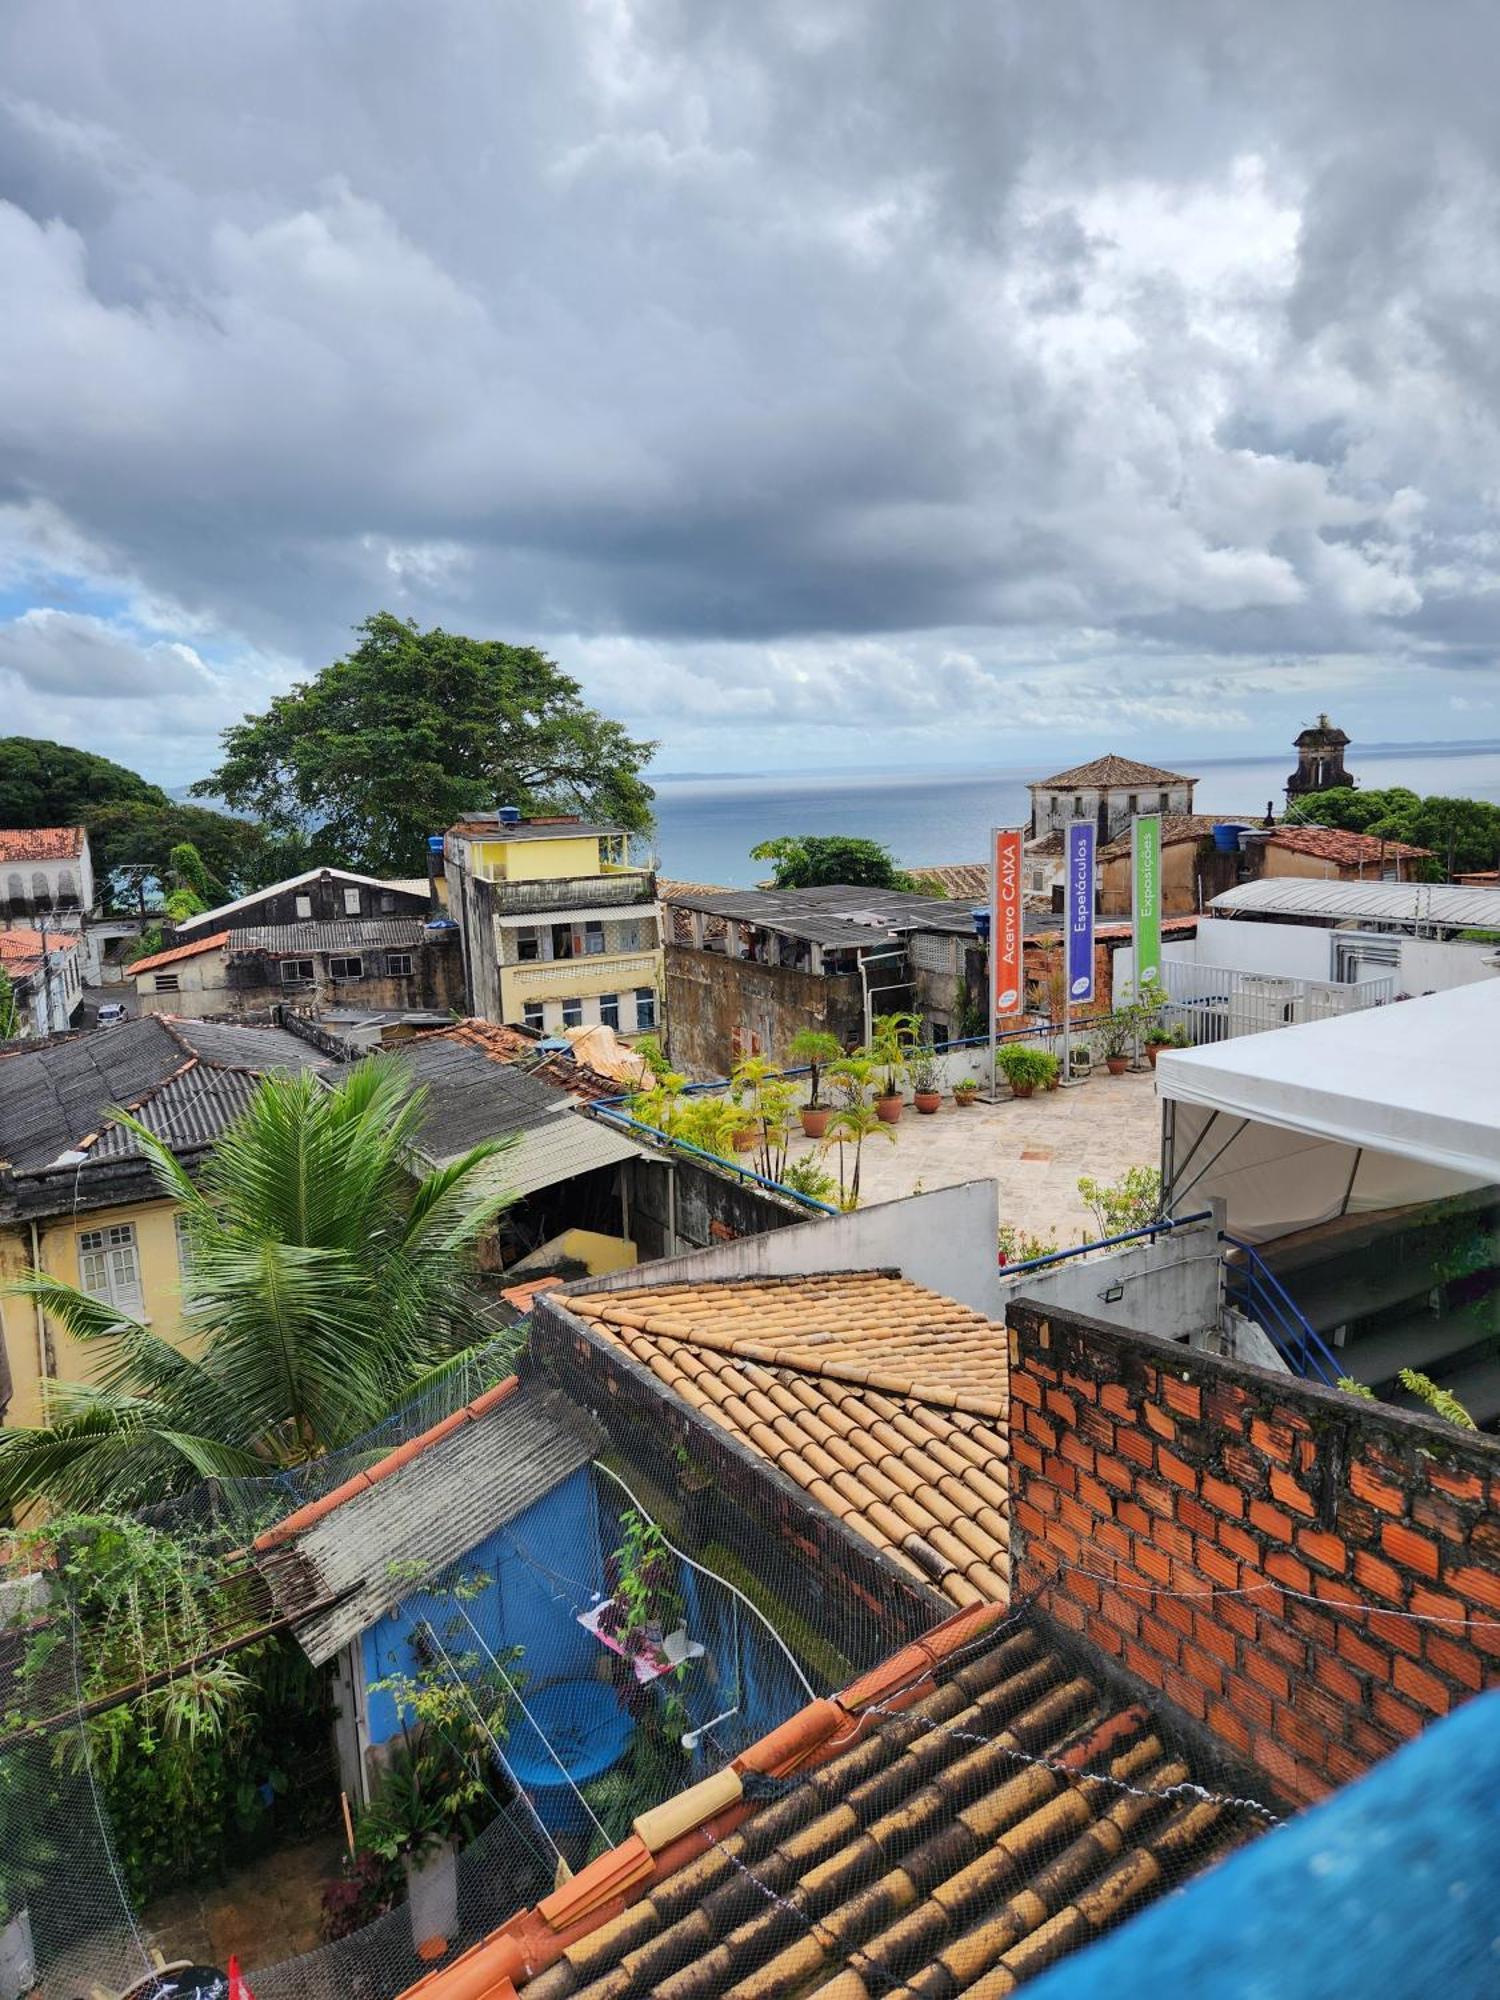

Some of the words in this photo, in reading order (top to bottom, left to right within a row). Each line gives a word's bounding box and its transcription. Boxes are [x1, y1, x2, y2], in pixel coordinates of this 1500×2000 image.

[1002, 845, 1015, 900] CAIXA
[1074, 839, 1089, 932] Espetáculos
[1141, 832, 1156, 917] Exposições
[1002, 906, 1015, 964] Acervo
